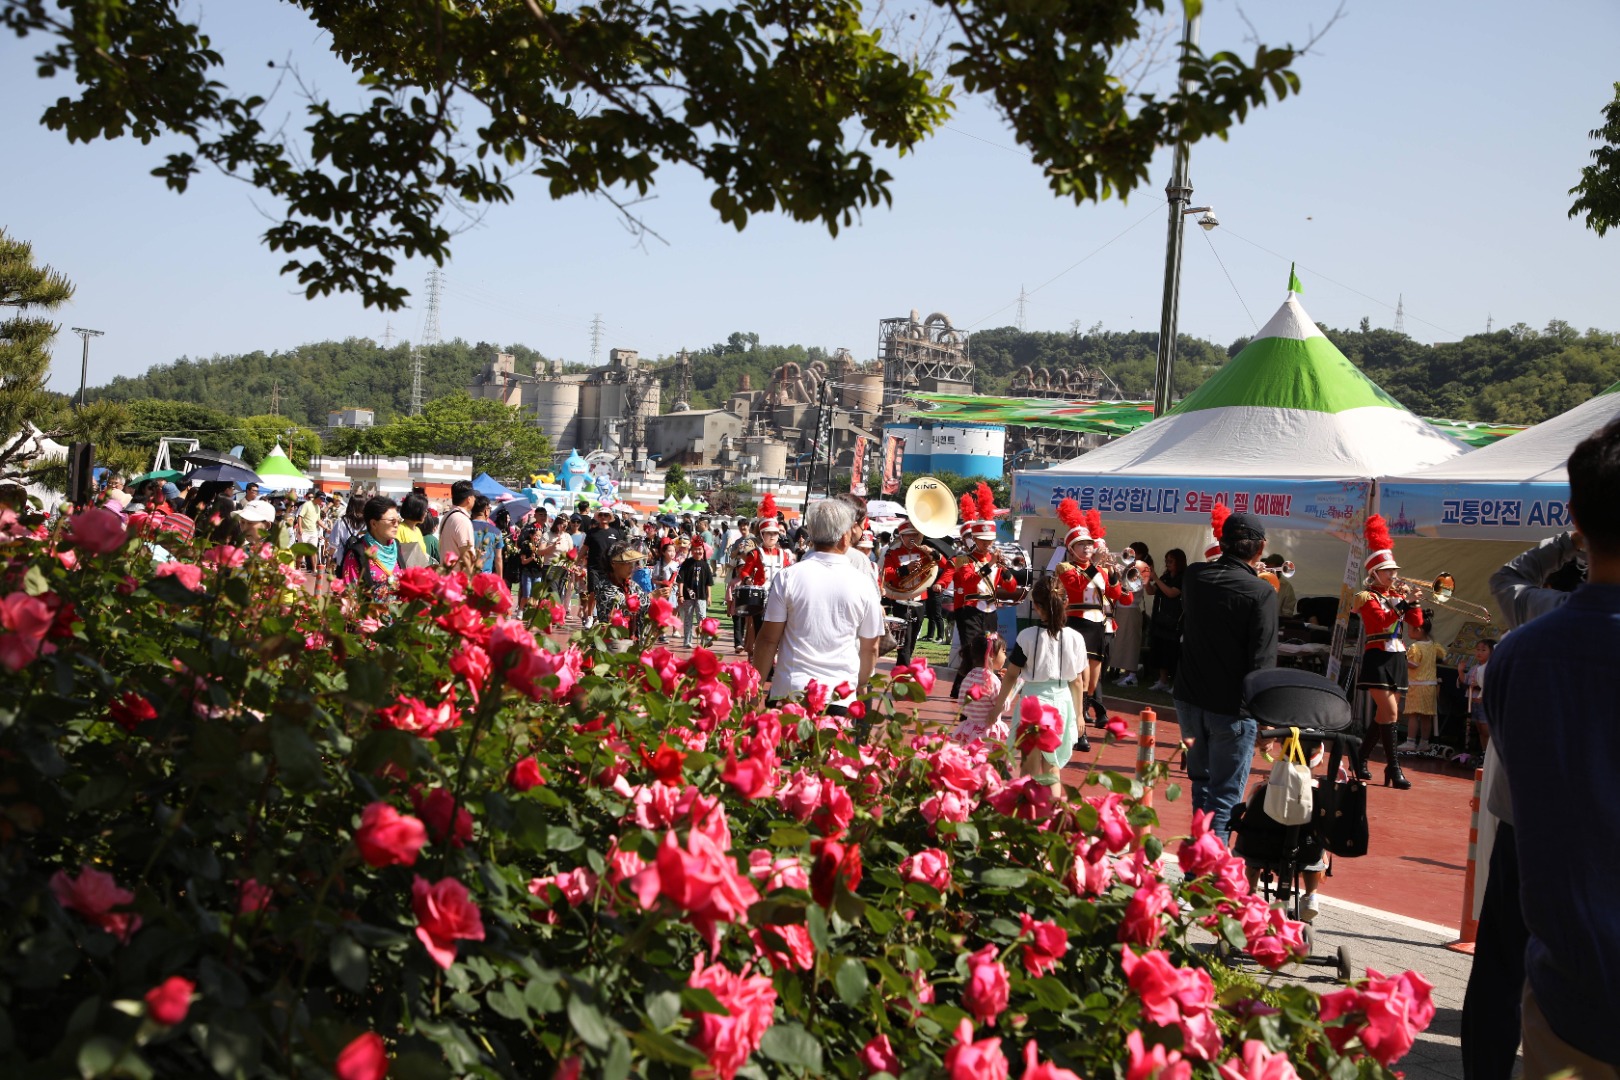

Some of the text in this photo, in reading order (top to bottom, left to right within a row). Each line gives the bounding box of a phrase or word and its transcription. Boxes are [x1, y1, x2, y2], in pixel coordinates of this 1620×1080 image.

[1098, 486, 1179, 513] 현상합니다
[1233, 493, 1249, 513] 젤
[1253, 494, 1292, 516] 예뻐!
[1442, 500, 1521, 526] 교통안전
